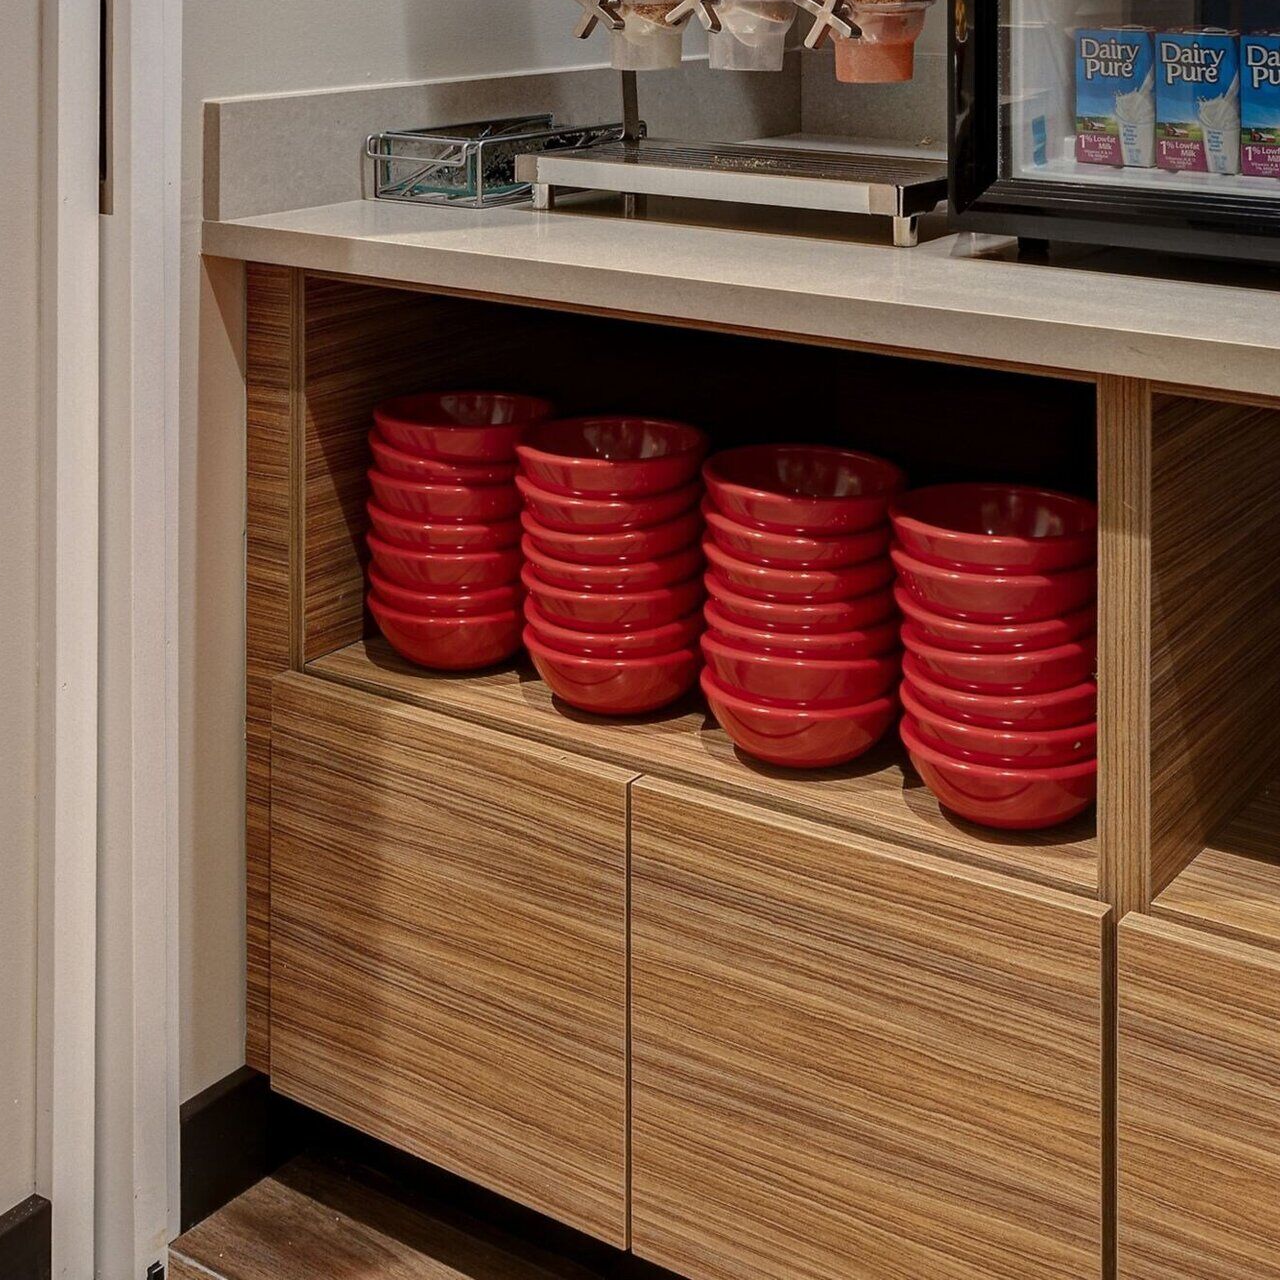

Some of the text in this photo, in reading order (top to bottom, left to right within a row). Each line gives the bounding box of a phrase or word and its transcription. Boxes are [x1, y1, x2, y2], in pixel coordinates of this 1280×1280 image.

[1081, 38, 1140, 62] Dairy
[1161, 42, 1224, 67] Dairy
[1086, 59, 1133, 79] Pure
[1167, 63, 1218, 84] Pure
[1079, 134, 1116, 149] 1% Lowfat
[1160, 140, 1200, 155] 1% Lowfat
[1180, 149, 1197, 157] Milk
[1245, 147, 1261, 161] 1%
